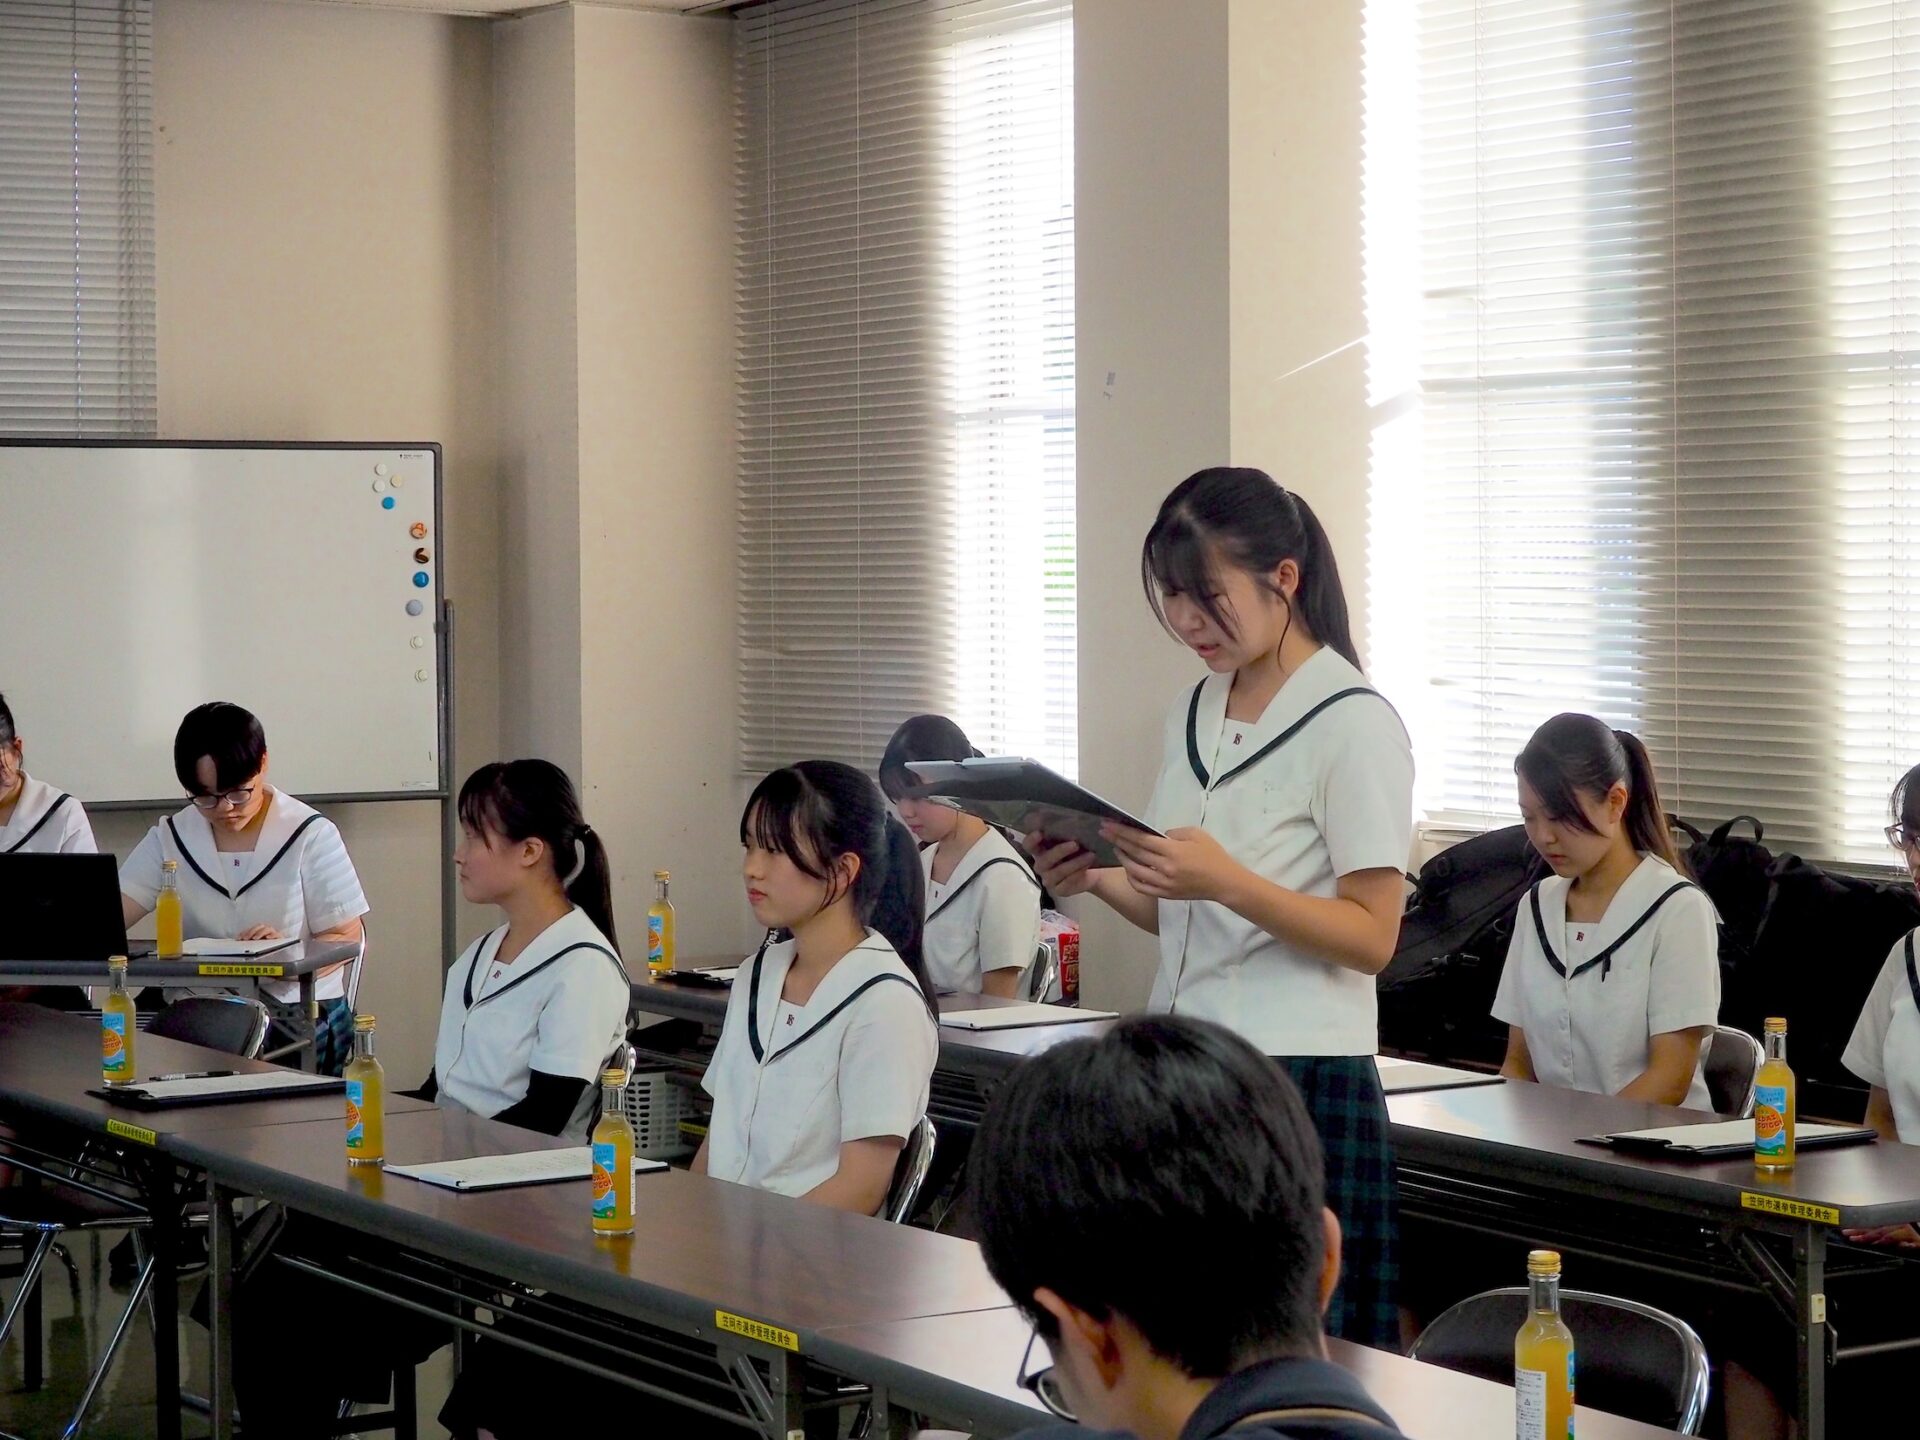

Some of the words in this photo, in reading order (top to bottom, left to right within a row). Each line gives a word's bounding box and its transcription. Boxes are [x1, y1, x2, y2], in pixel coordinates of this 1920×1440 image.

[1750, 1196, 1831, 1220] 笠岡市選挙管理委員会
[722, 1315, 790, 1346] 笠岡市選挙管理委員会
